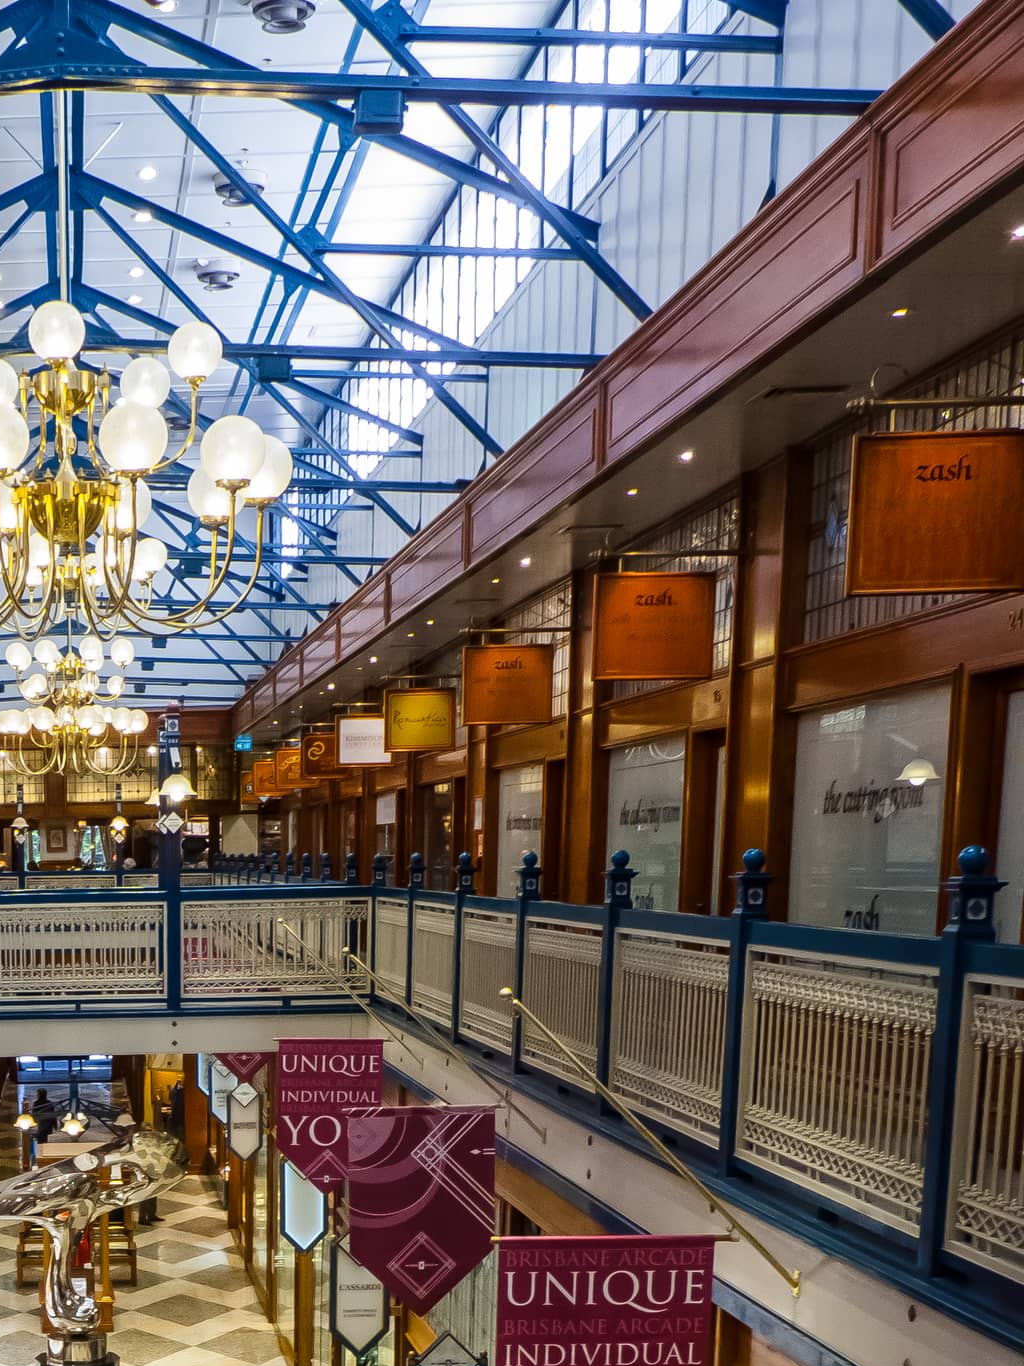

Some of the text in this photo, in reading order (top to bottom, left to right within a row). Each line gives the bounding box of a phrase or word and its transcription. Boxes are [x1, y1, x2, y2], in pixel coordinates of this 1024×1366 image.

[916, 455, 973, 482] zash
[634, 588, 674, 607] zash
[494, 656, 523, 671] zash
[282, 1055, 380, 1077] UNIQUE
[282, 1091, 379, 1104] INDIVIDUAL
[281, 1115, 342, 1147] YO
[506, 1249, 709, 1268] BRISBANE ARCADE
[504, 1270, 706, 1313] UNIQUE
[504, 1317, 705, 1336] BRISBANE ARCADE
[504, 1342, 703, 1366] INDIVIDUAL
